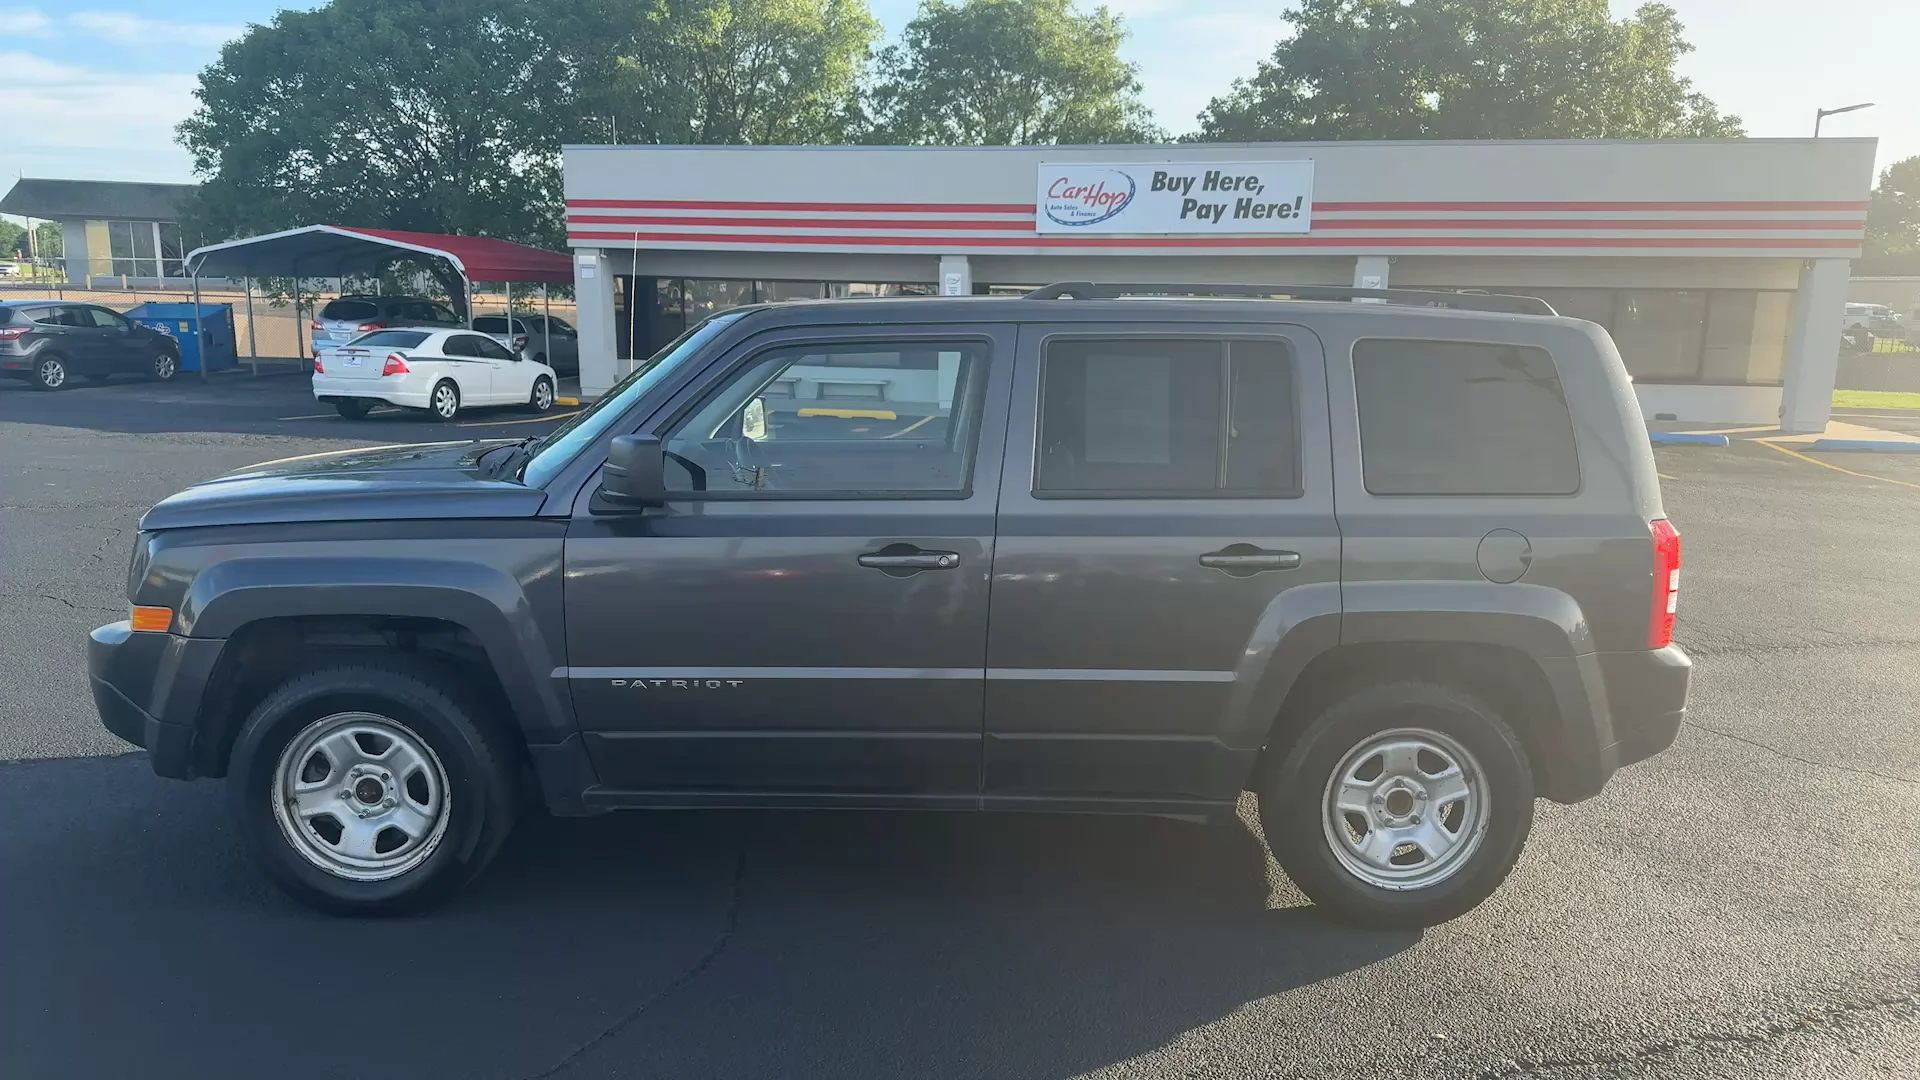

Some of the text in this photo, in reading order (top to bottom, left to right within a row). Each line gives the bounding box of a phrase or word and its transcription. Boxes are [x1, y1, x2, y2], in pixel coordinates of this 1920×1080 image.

[1048, 177, 1126, 216] CarHop
[1150, 170, 1265, 196] Buy Here,
[1180, 196, 1303, 224] Pay Here!
[611, 679, 744, 690] PATRIOT
